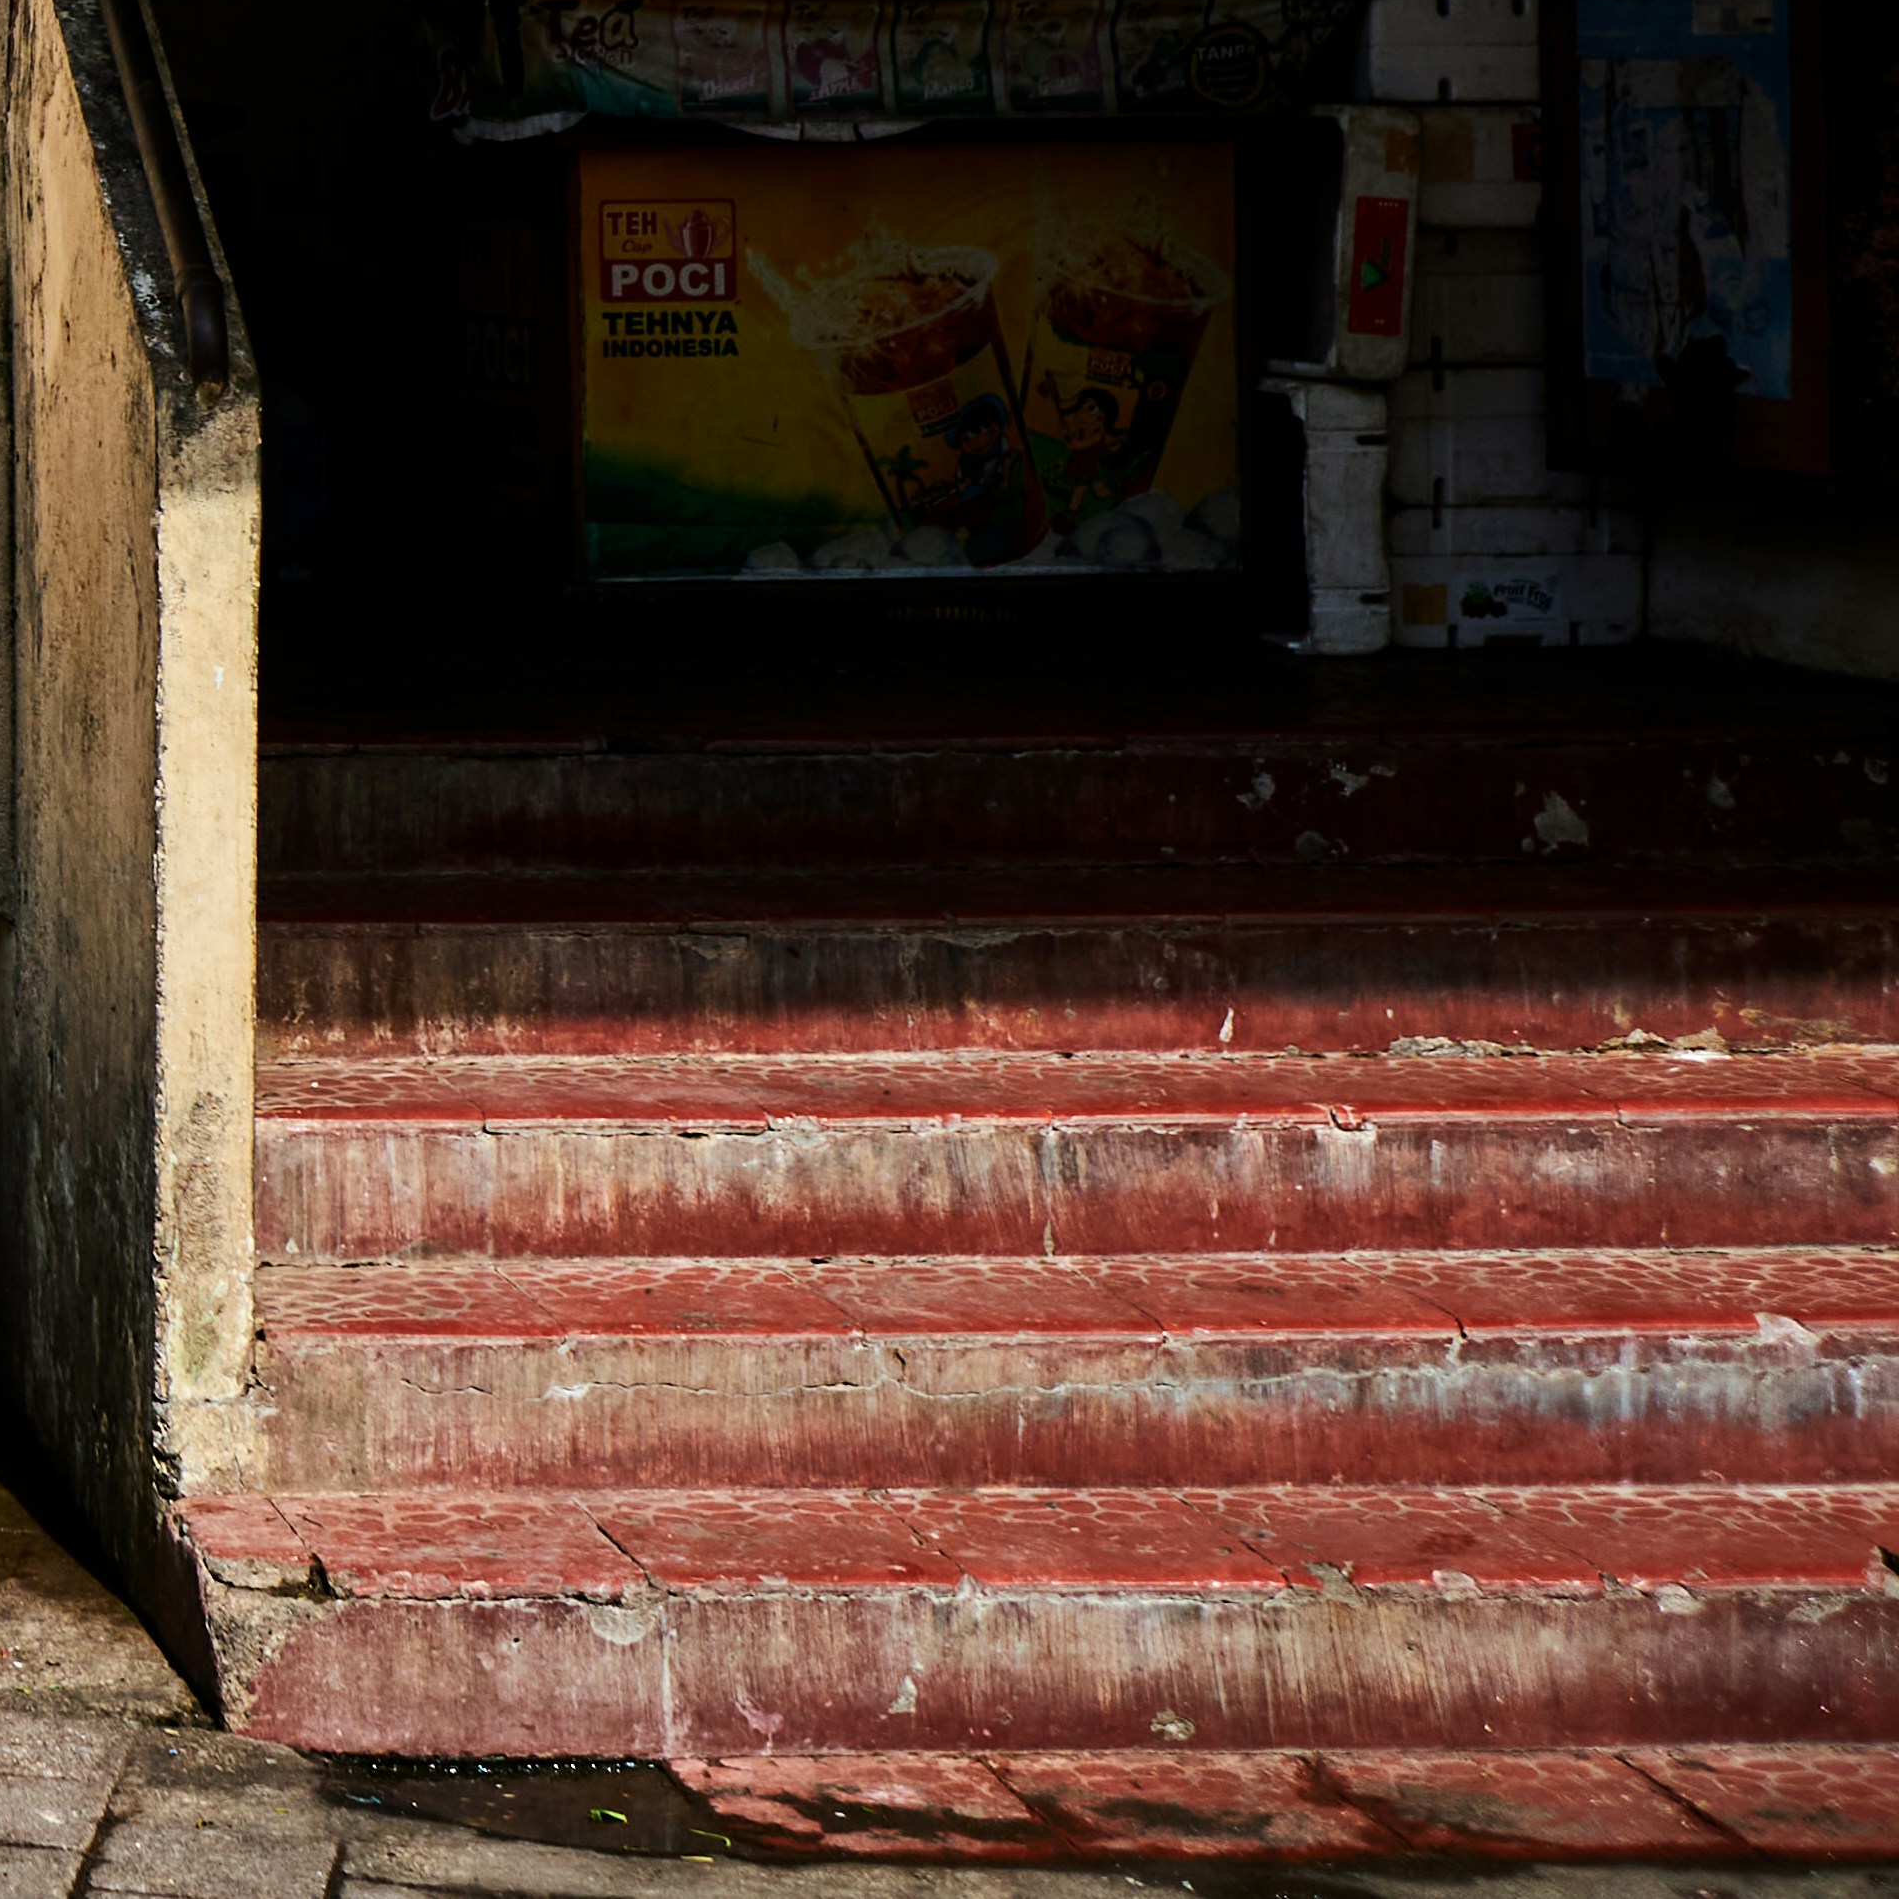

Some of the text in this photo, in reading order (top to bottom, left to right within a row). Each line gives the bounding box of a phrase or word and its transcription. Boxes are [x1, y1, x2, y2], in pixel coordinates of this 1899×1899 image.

[605, 210, 658, 237] TEH
[610, 262, 727, 298] POCI
[602, 310, 739, 335] TEHNYA
[602, 339, 740, 358] INDONESIA
